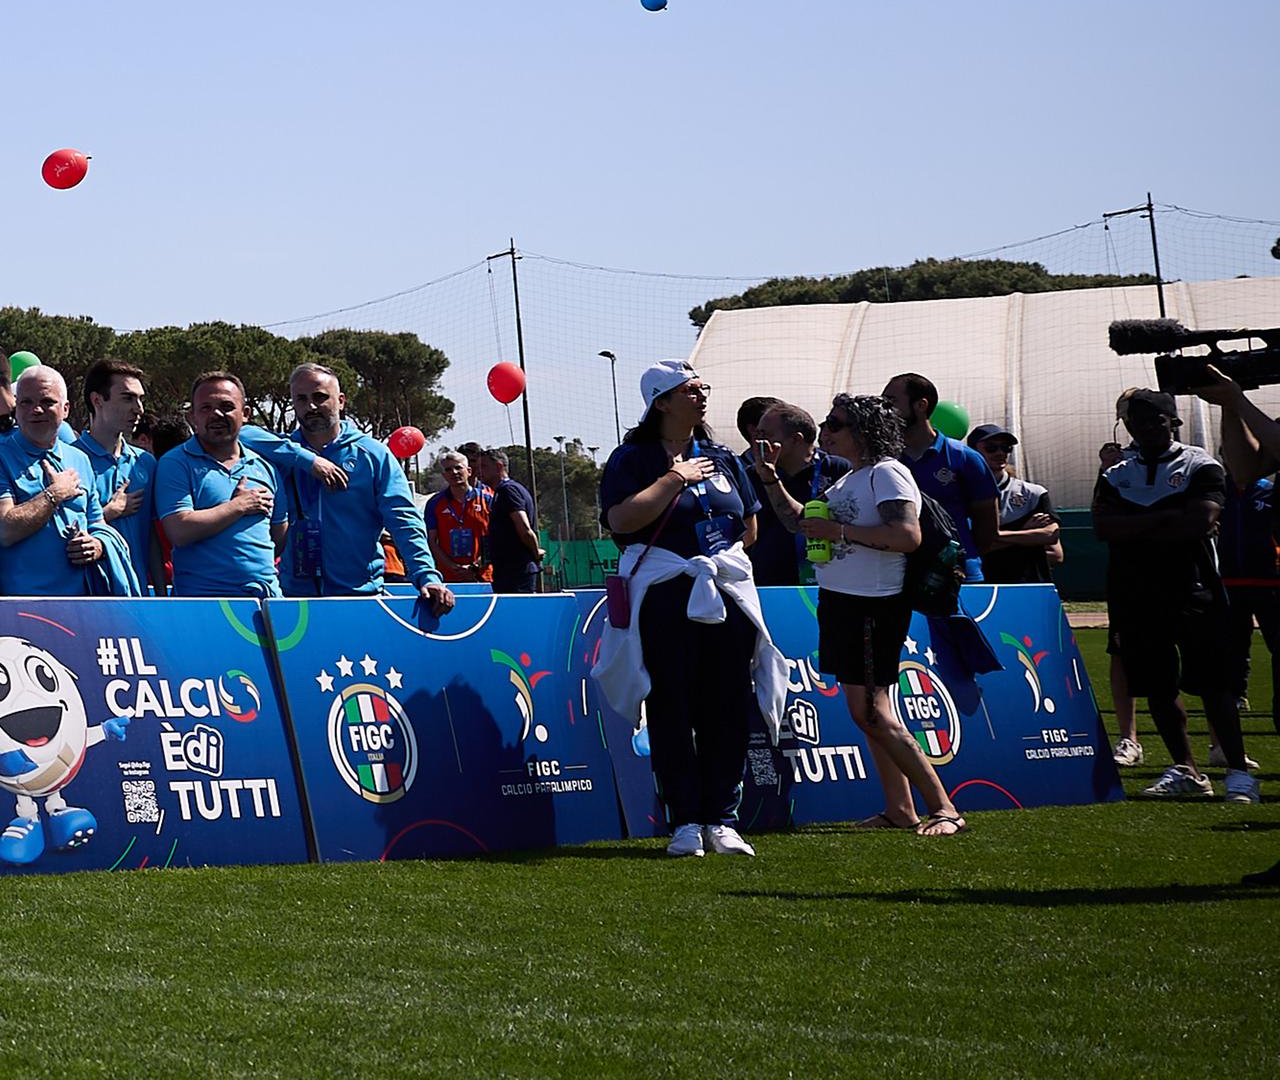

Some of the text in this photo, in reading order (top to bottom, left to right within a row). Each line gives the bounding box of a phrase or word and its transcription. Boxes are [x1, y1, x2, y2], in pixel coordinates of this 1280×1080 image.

[96, 638, 158, 676] #IL
[903, 696, 941, 721] FIGC
[348, 723, 394, 752] FIGC
[1042, 729, 1068, 743] FIGC
[782, 746, 866, 783] TUTTI
[1025, 746, 1095, 760] CALCIO PARALIMPICO
[527, 760, 560, 777] FIGC
[169, 778, 281, 821] TUTTI
[501, 779, 592, 796] CALCIO PARALIMPICO
